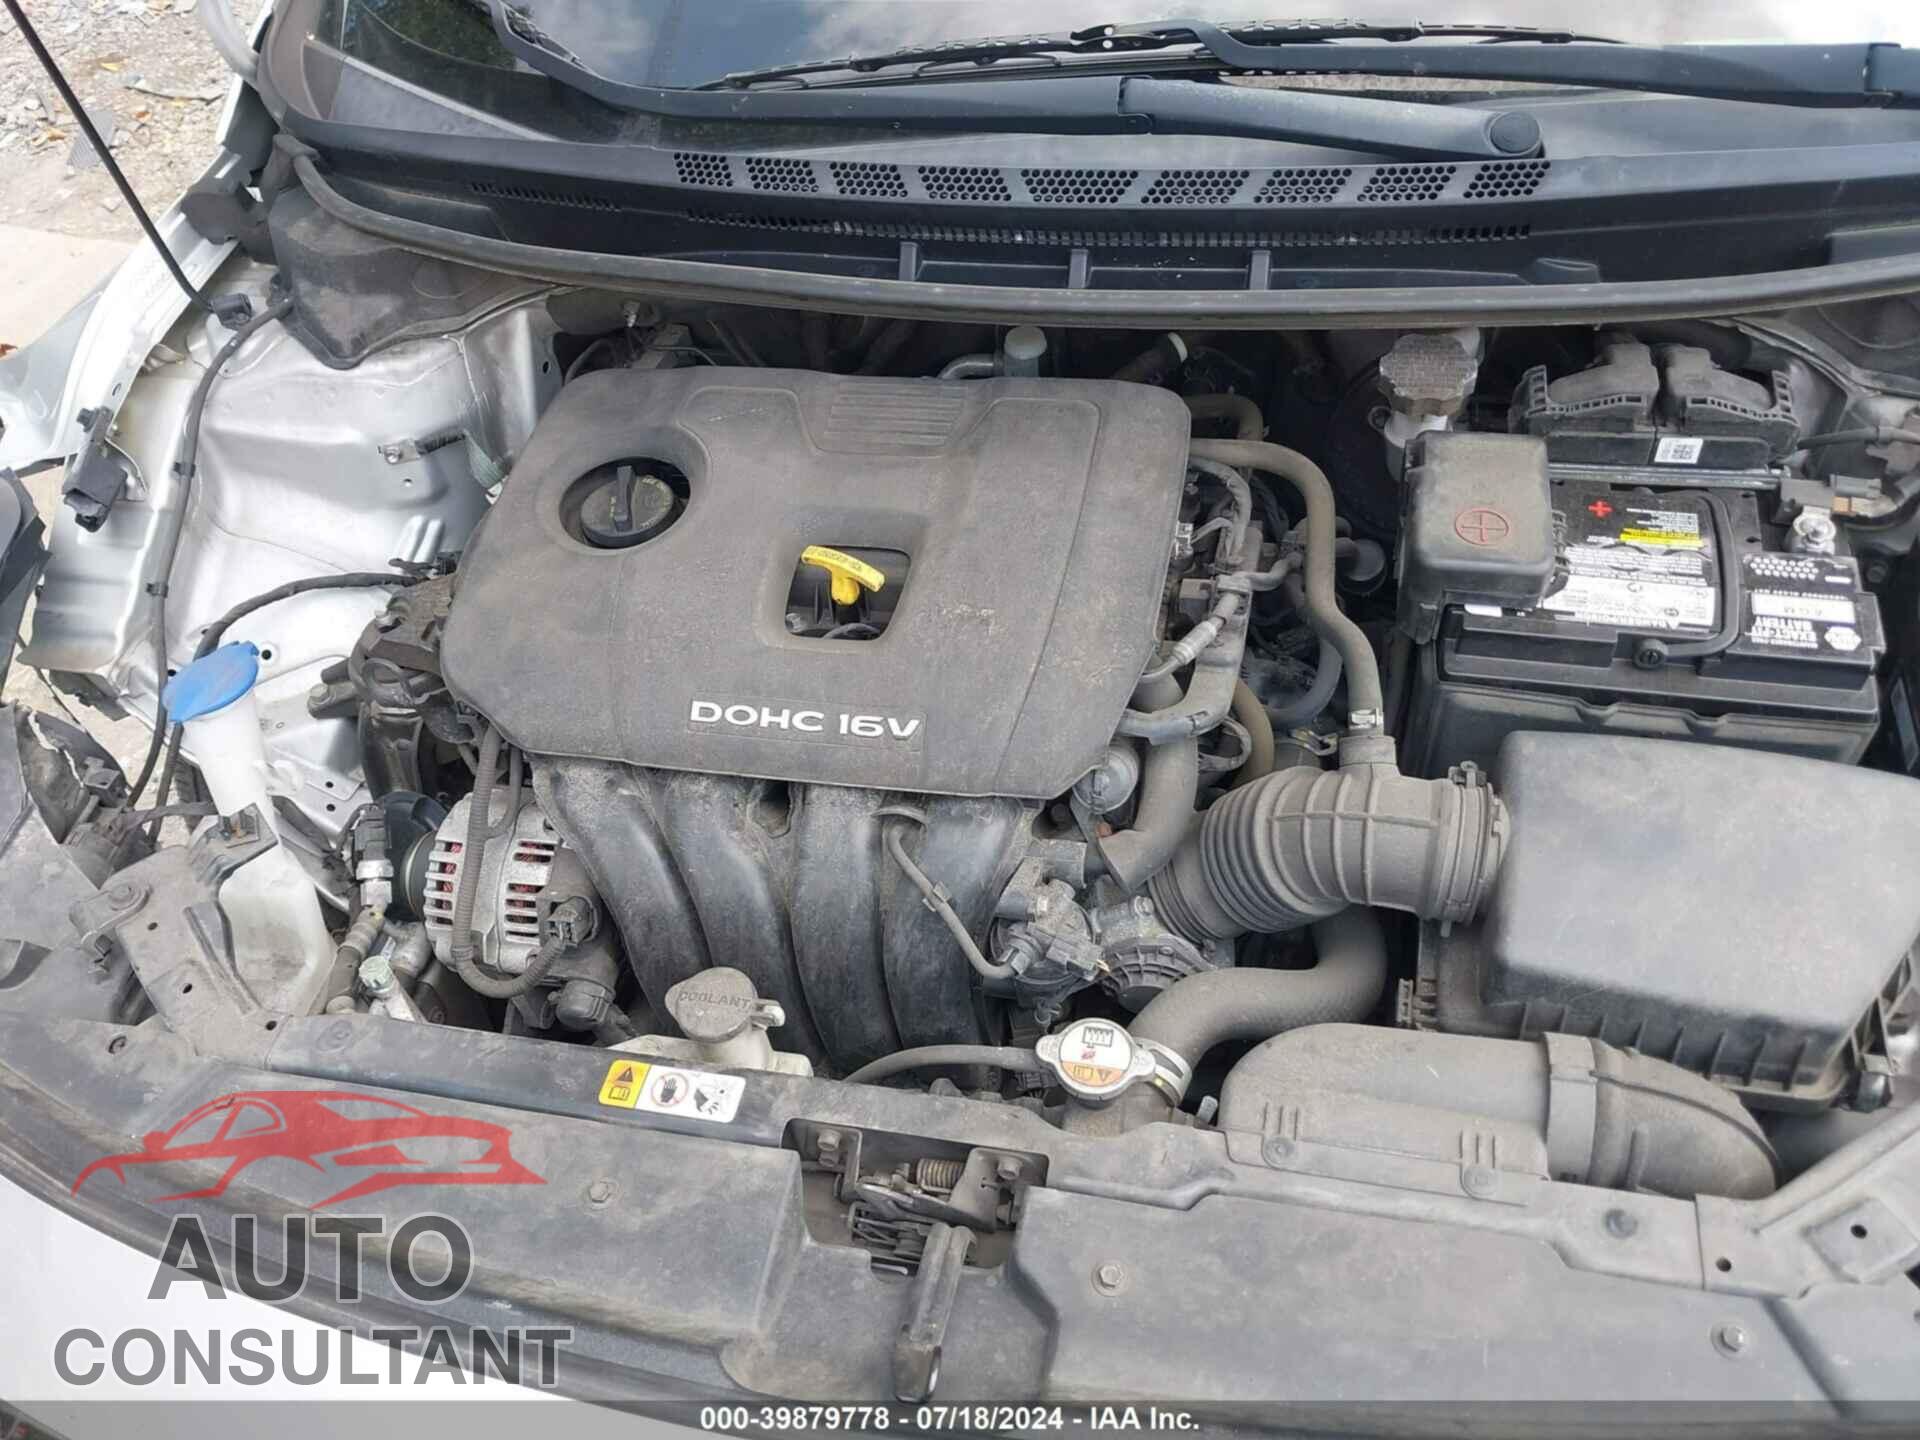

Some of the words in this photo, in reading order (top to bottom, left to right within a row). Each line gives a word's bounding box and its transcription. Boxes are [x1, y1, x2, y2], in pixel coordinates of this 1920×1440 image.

[1754, 616, 1812, 630] BATTERY
[690, 701, 825, 731] DOHC
[839, 713, 921, 738] 16V
[678, 990, 752, 1010] COOLANT
